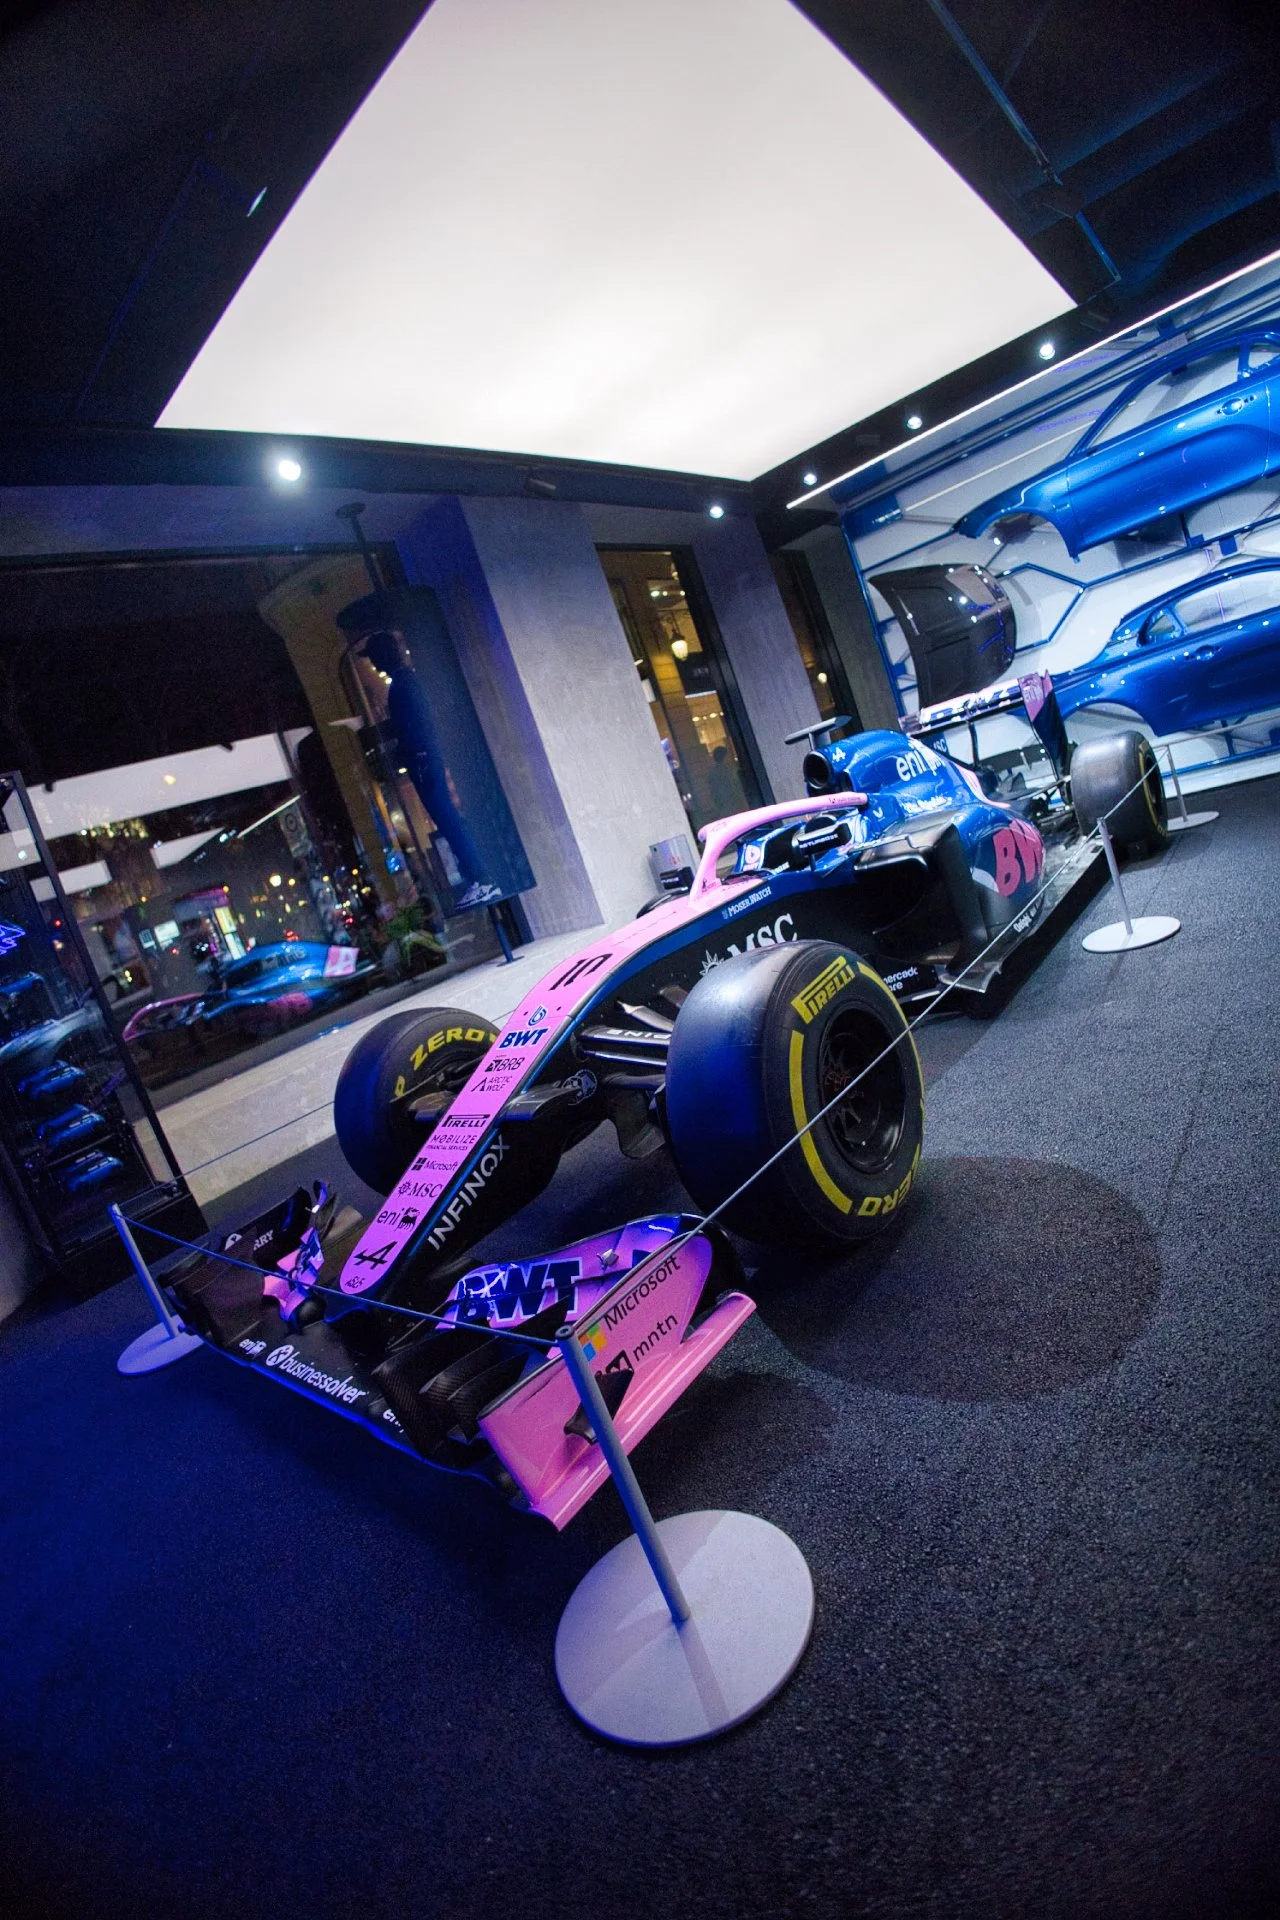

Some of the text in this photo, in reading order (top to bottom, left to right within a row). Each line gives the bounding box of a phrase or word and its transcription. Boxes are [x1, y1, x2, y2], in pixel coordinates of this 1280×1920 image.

[790, 955, 856, 1025] PIRELLI
[410, 1027, 485, 1071] ZERO
[498, 1028, 549, 1049] BWT
[441, 1114, 491, 1128] PIRELLI
[424, 1160, 458, 1171] Microsoft
[408, 1182, 443, 1198] MSC
[377, 1207, 405, 1226] eni
[455, 1258, 583, 1323] BWT
[602, 1254, 681, 1331] Microsoft
[633, 1314, 679, 1363] mntn
[279, 1351, 367, 1404] businessolver
